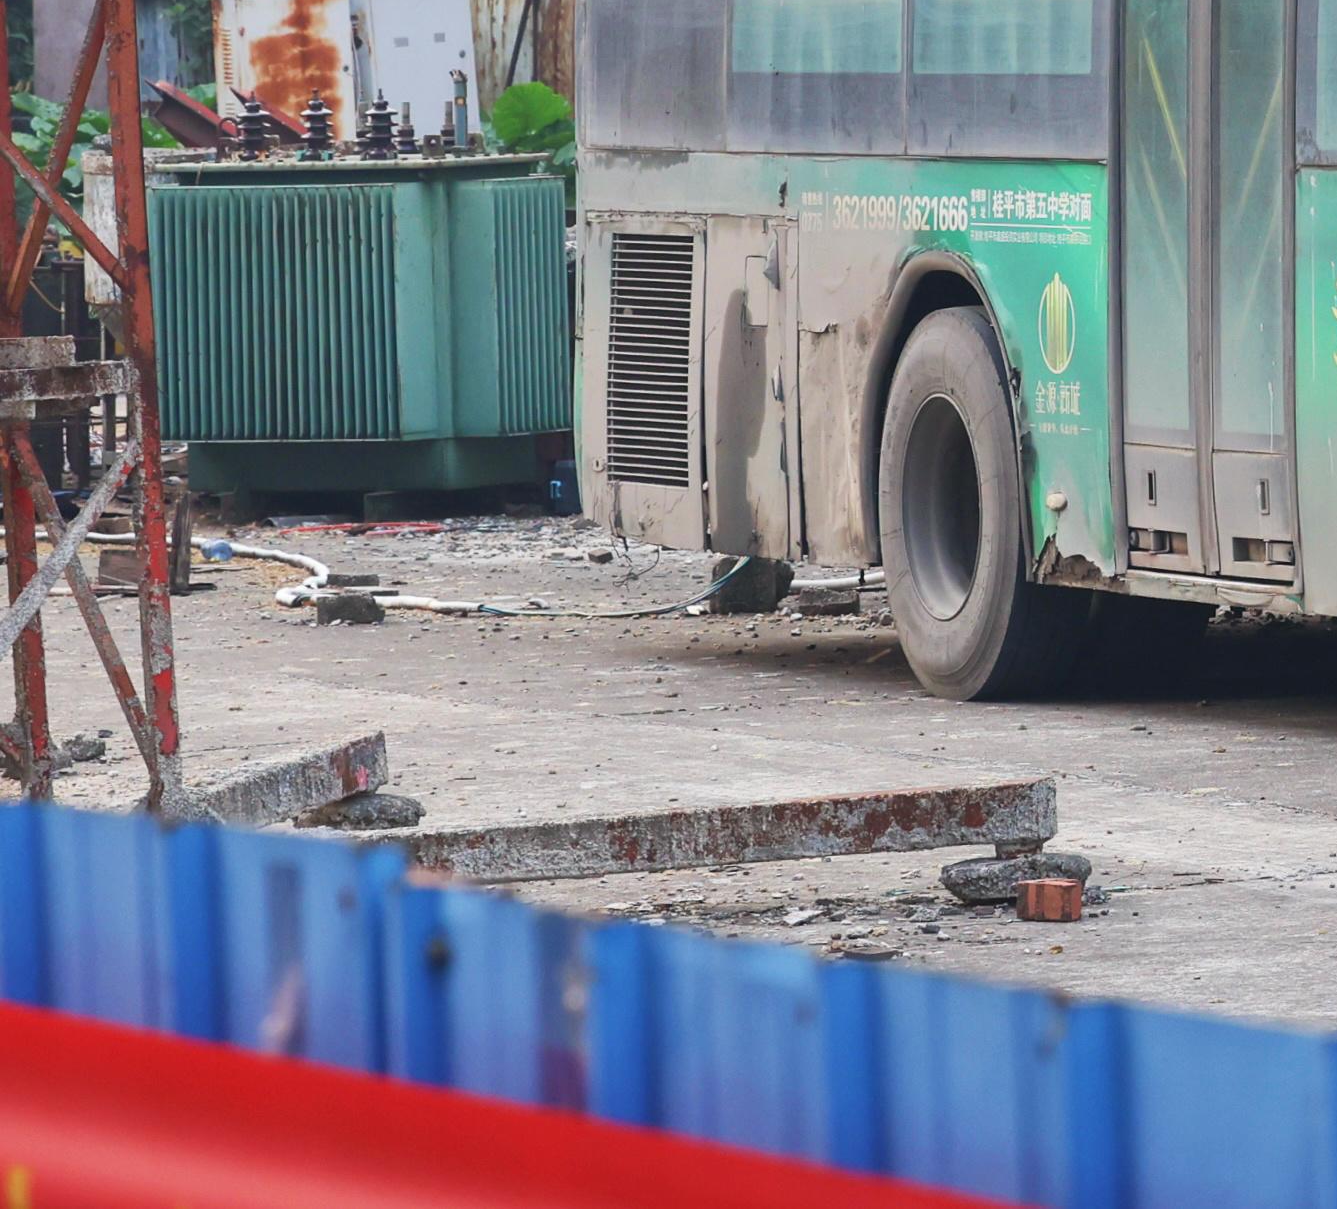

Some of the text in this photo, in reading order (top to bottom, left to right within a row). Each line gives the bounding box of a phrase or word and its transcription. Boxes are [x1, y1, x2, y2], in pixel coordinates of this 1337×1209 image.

[832, 195, 968, 232] 3621999/3621666
[992, 189, 1092, 222] 桂平市第五中学对面
